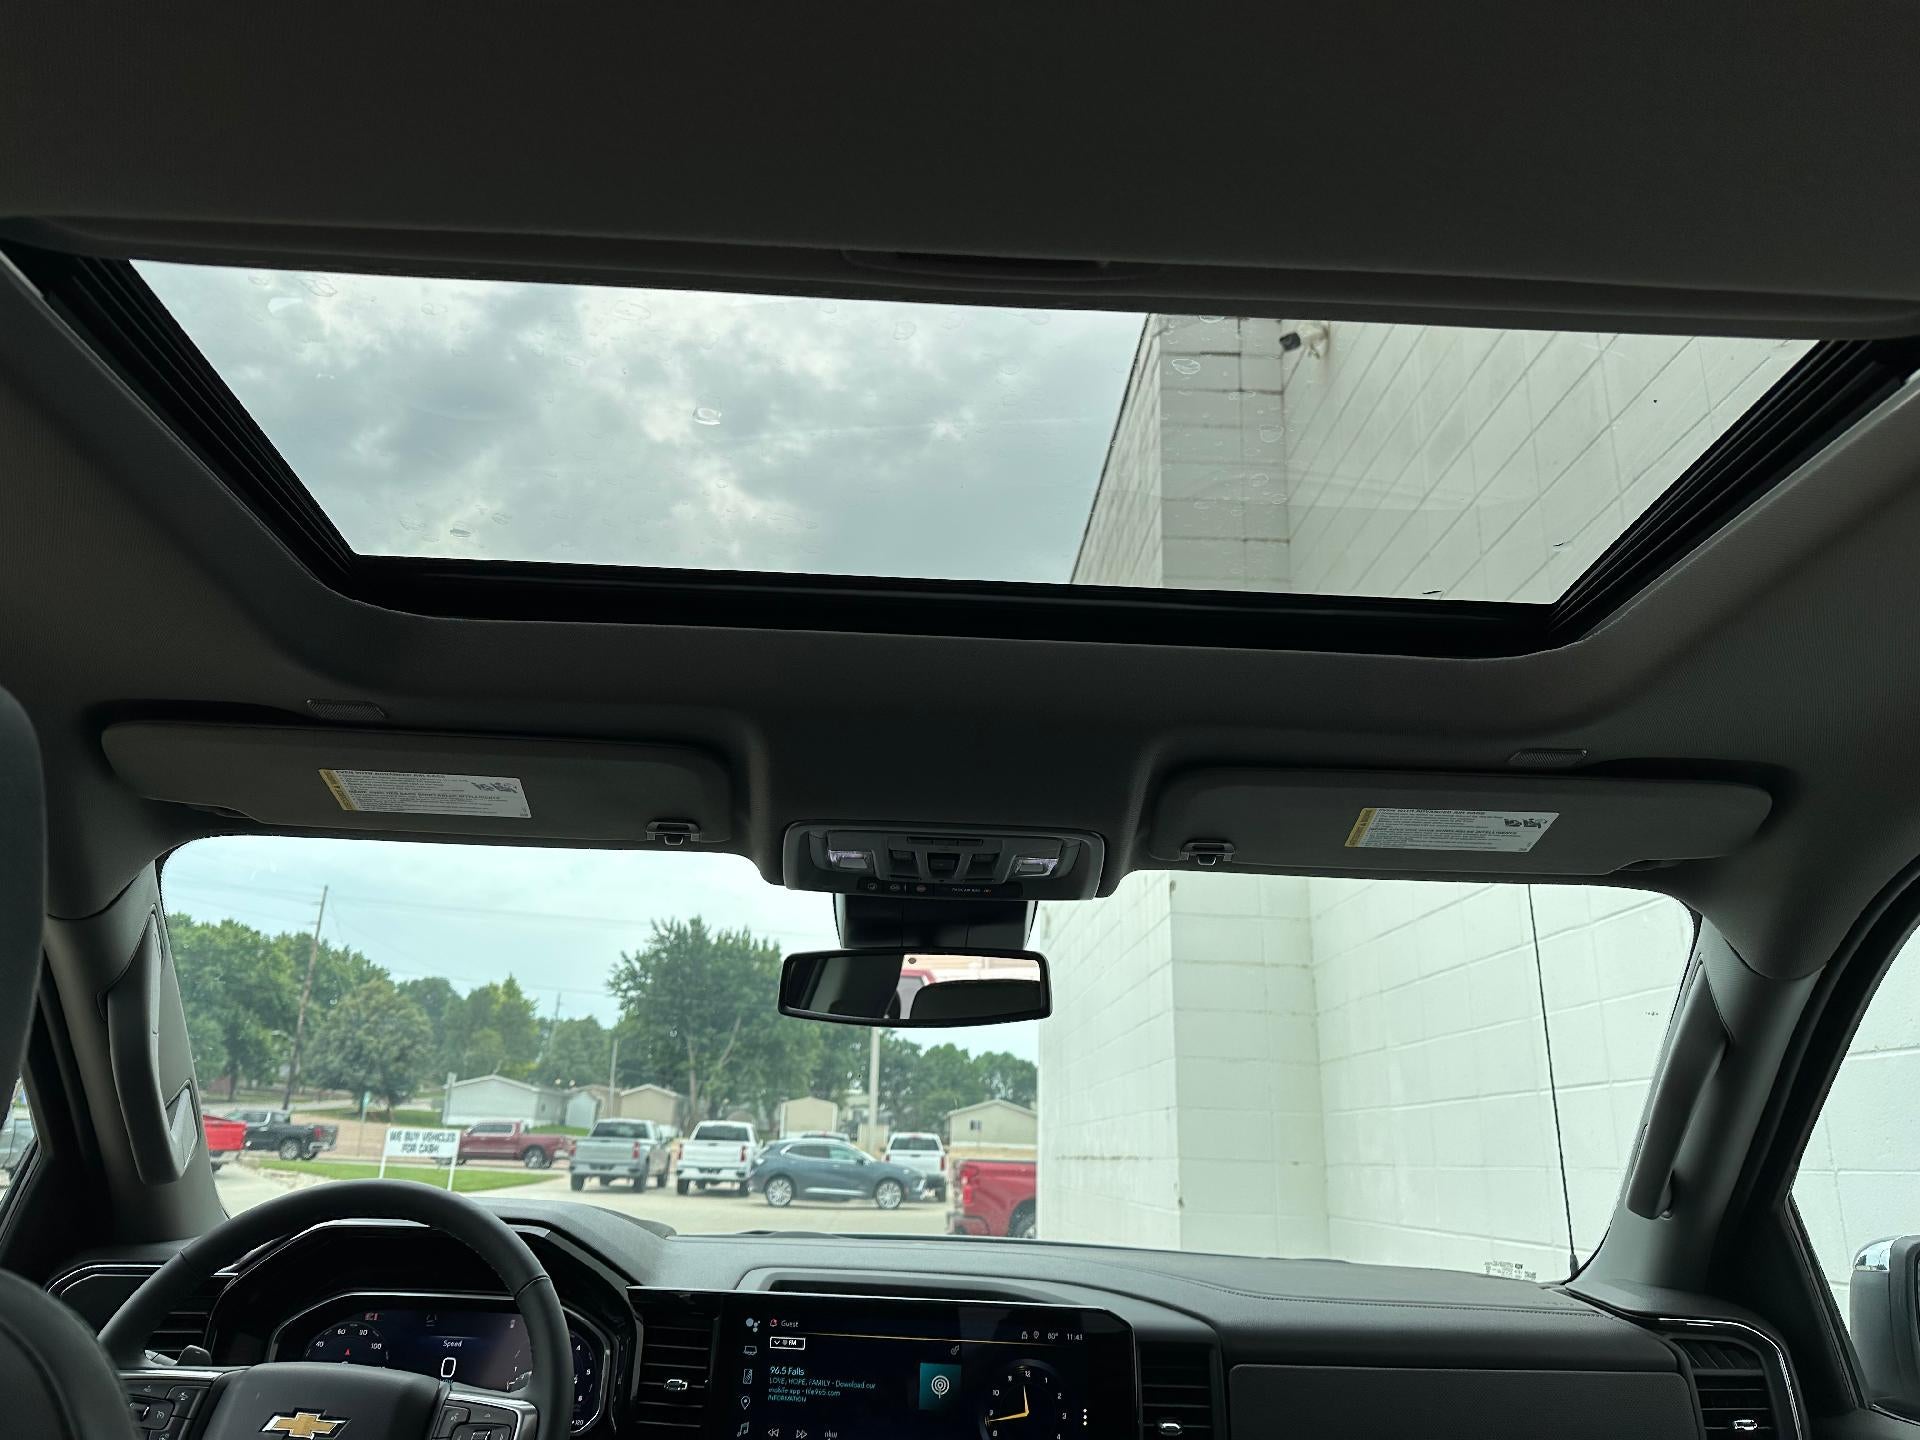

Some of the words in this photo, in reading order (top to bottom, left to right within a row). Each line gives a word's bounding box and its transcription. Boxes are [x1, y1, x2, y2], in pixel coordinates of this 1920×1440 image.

[390, 1130, 402, 1141] WE
[404, 1130, 419, 1142] BUY
[421, 1131, 456, 1143] VEHICLES
[401, 1143, 416, 1153] FOR
[419, 1144, 439, 1154] CASH
[781, 1320, 799, 1328] Guest
[315, 1340, 324, 1348] 40
[371, 1342, 382, 1350] 100
[442, 1339, 463, 1348] Speed
[440, 1357, 457, 1378] 0
[770, 1366, 787, 1375] 96.5
[787, 1367, 805, 1376] Falls
[836, 1380, 865, 1389] Download
[768, 1386, 789, 1394] mobile
[789, 1388, 801, 1396] app
[992, 1389, 1000, 1397] 10
[767, 1394, 807, 1403] INFORMATION
